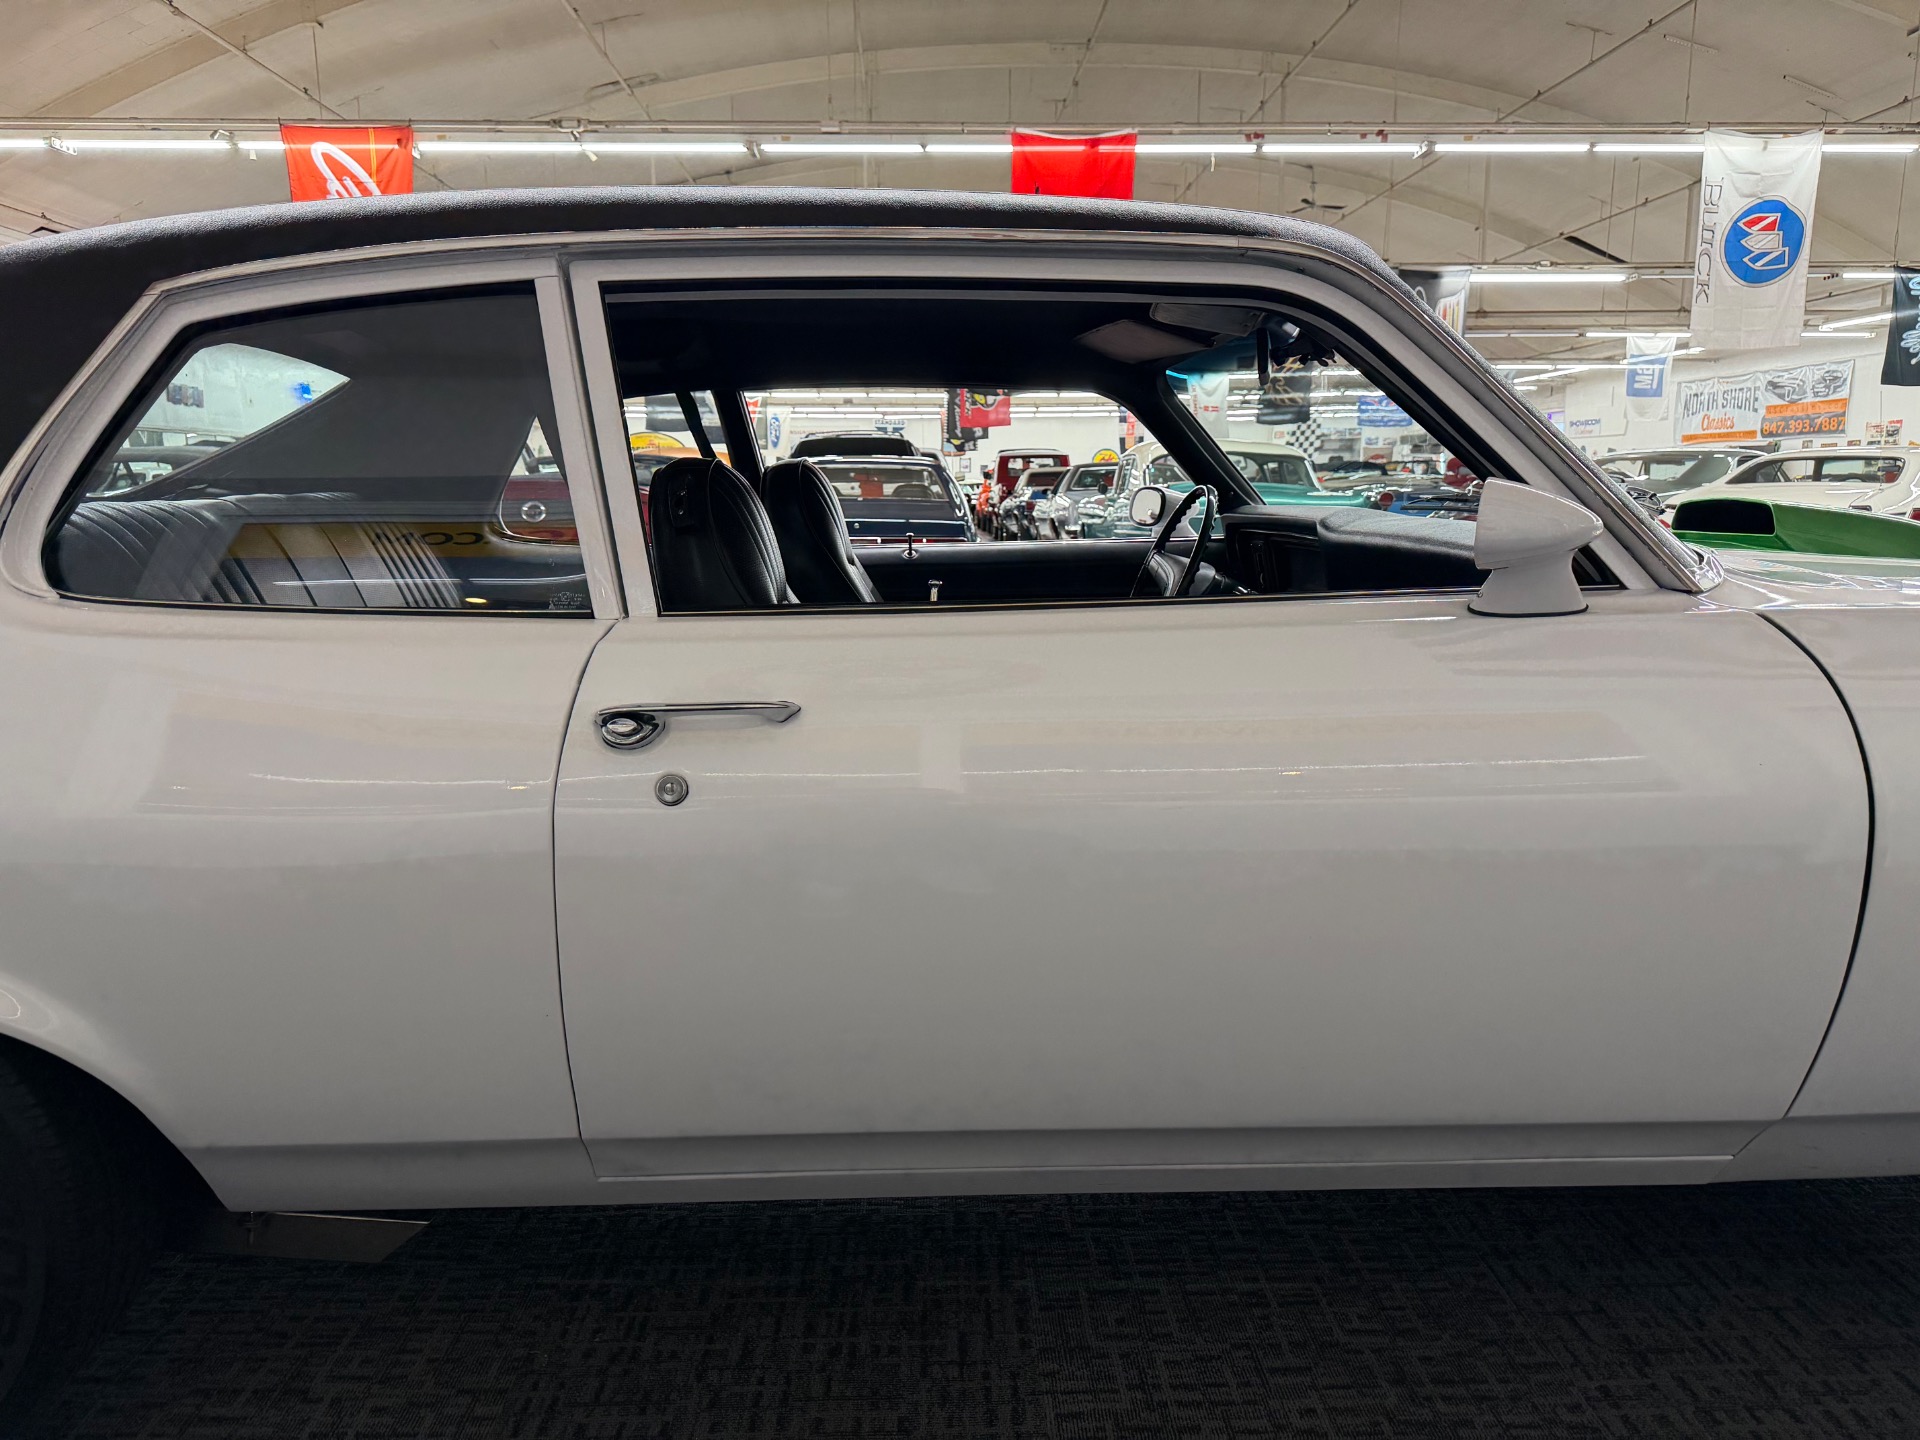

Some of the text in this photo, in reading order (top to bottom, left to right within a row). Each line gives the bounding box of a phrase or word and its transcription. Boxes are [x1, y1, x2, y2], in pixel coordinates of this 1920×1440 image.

[1695, 176, 1724, 303] BUICK
[1682, 390, 1719, 420] NORTH
[1722, 386, 1760, 413] SHORE
[1701, 413, 1735, 432] Classics
[1762, 416, 1846, 434] 847.393.7887
